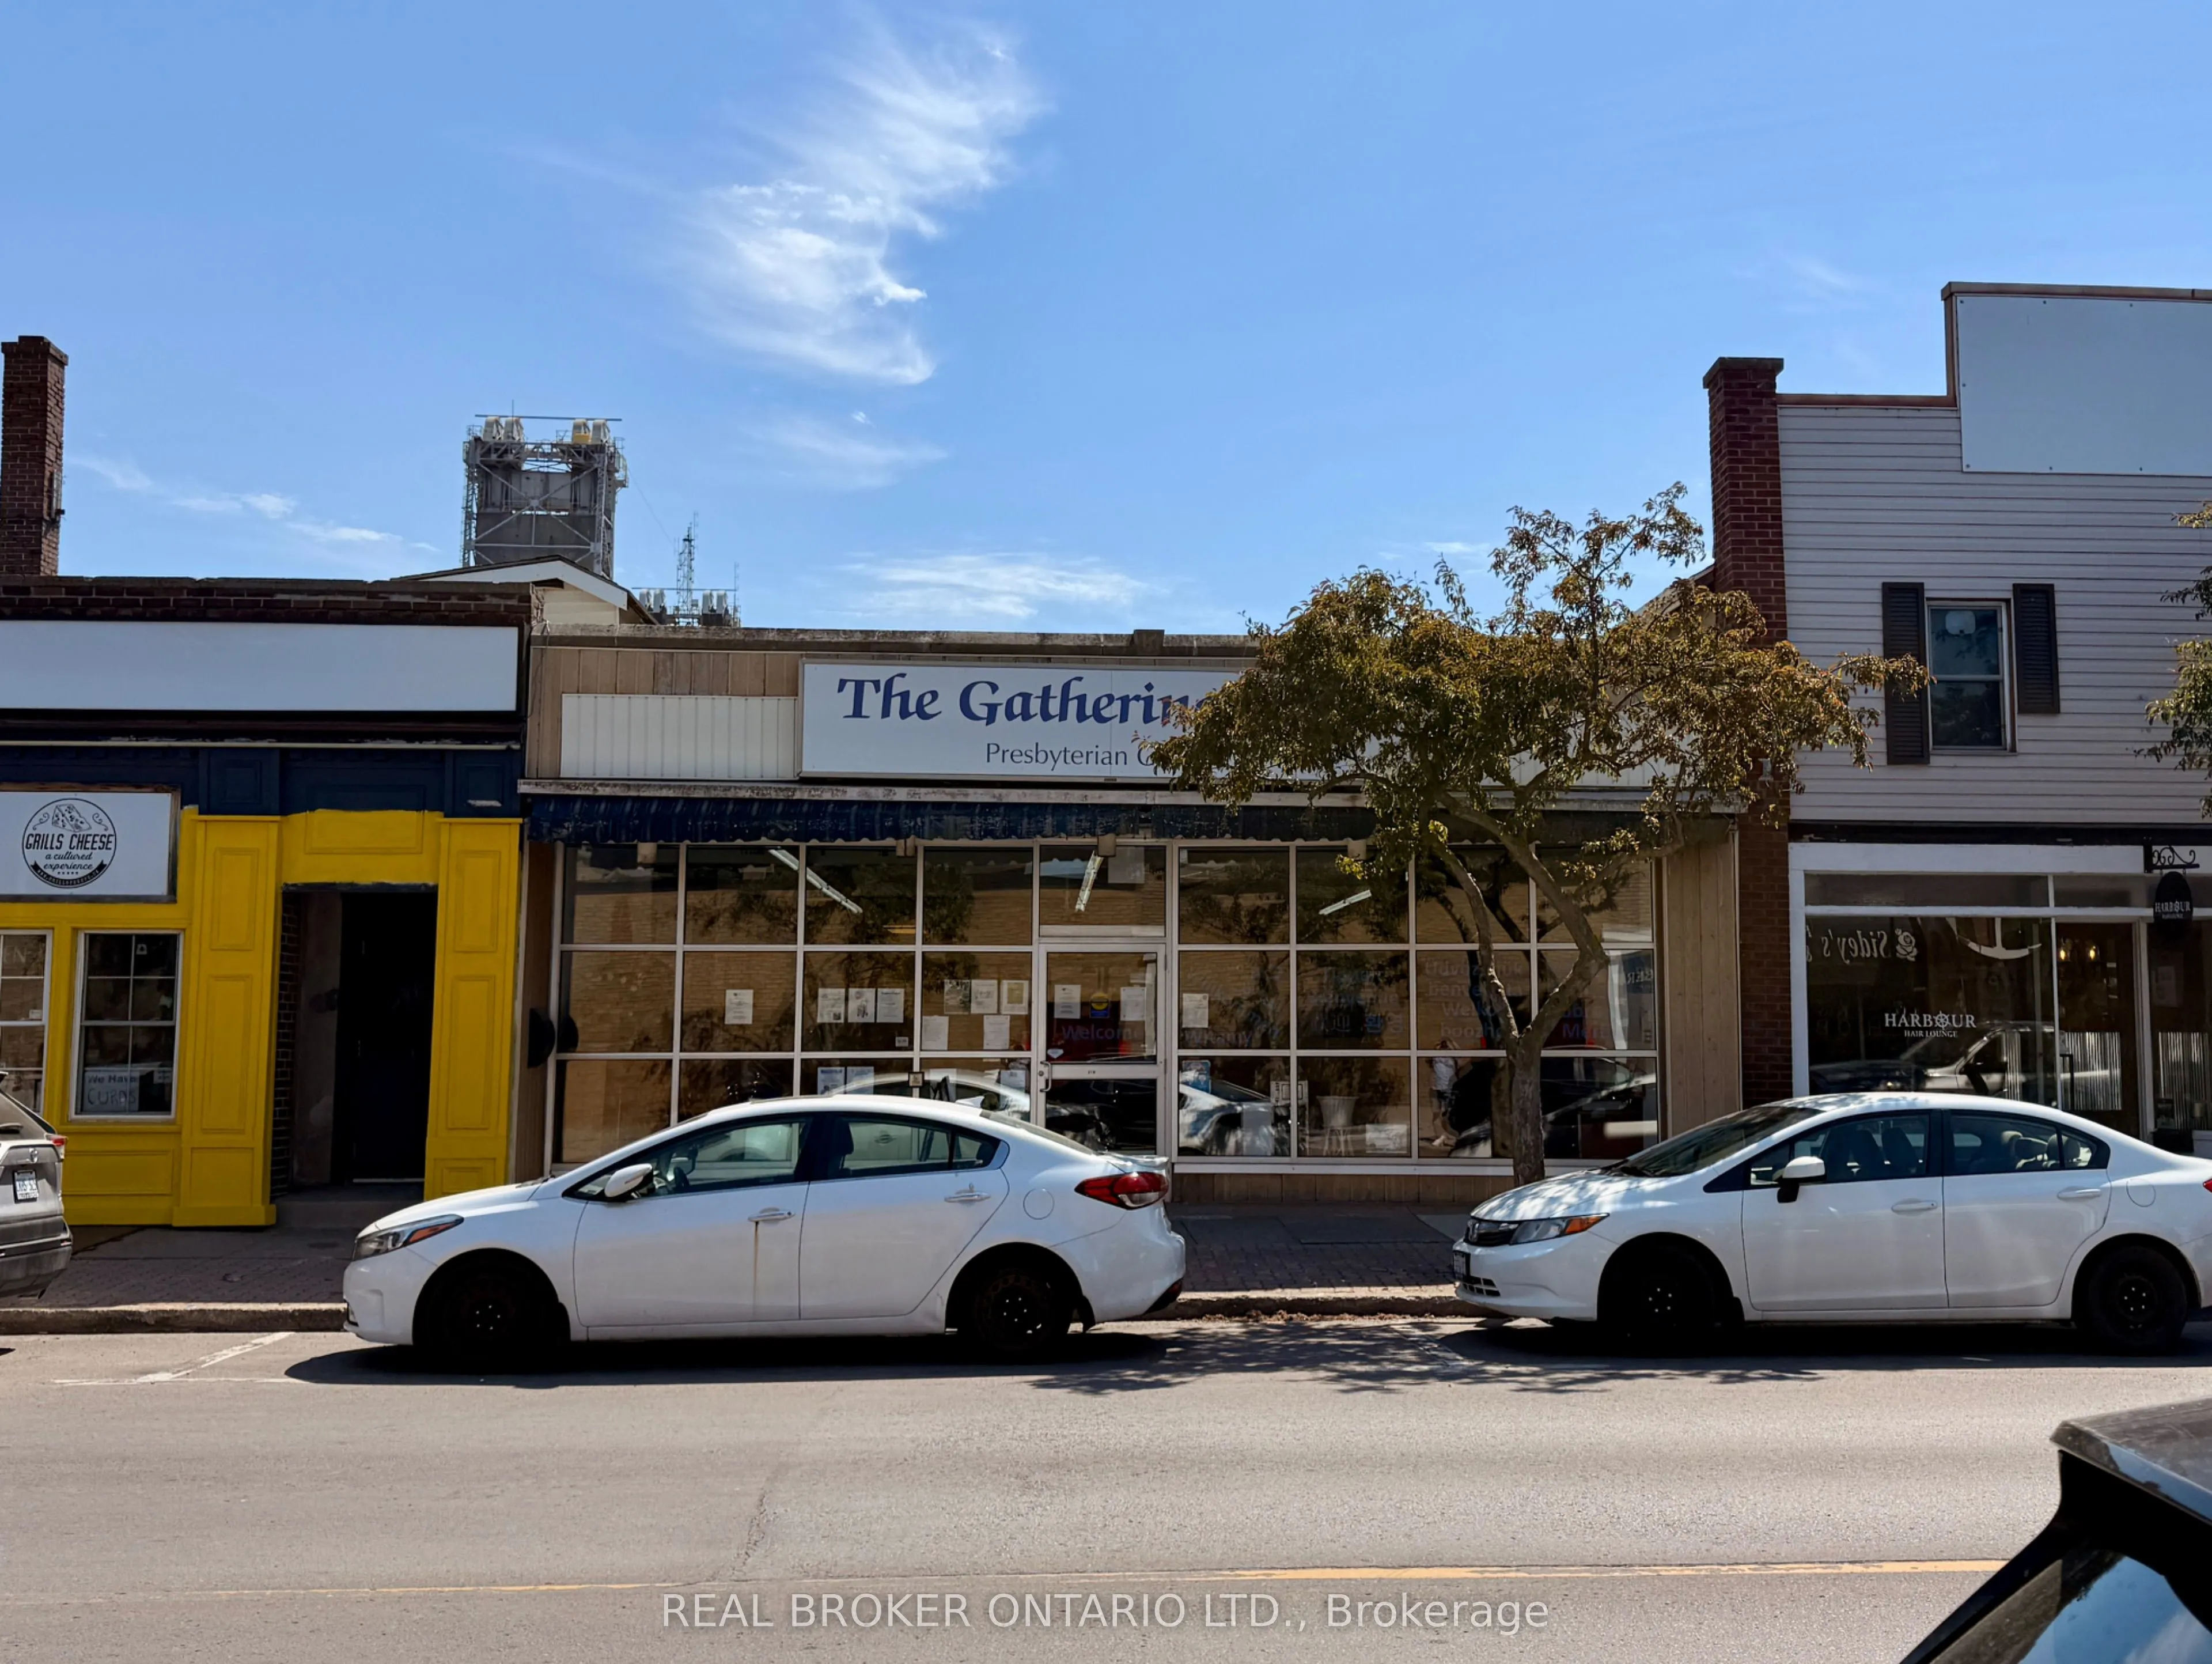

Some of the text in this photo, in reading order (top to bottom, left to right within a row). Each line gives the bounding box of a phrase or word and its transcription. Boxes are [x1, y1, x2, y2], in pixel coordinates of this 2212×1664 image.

[837, 672, 1213, 727] The Gatherin
[986, 743, 1127, 771] Presbyterian
[25, 833, 114, 850] GRILLS CHEESE
[53, 850, 93, 860] cultured
[43, 862, 94, 872] experience
[1884, 1009, 1977, 1030] HARBOUR
[1904, 1030, 1959, 1038] HAIR LOUNGE
